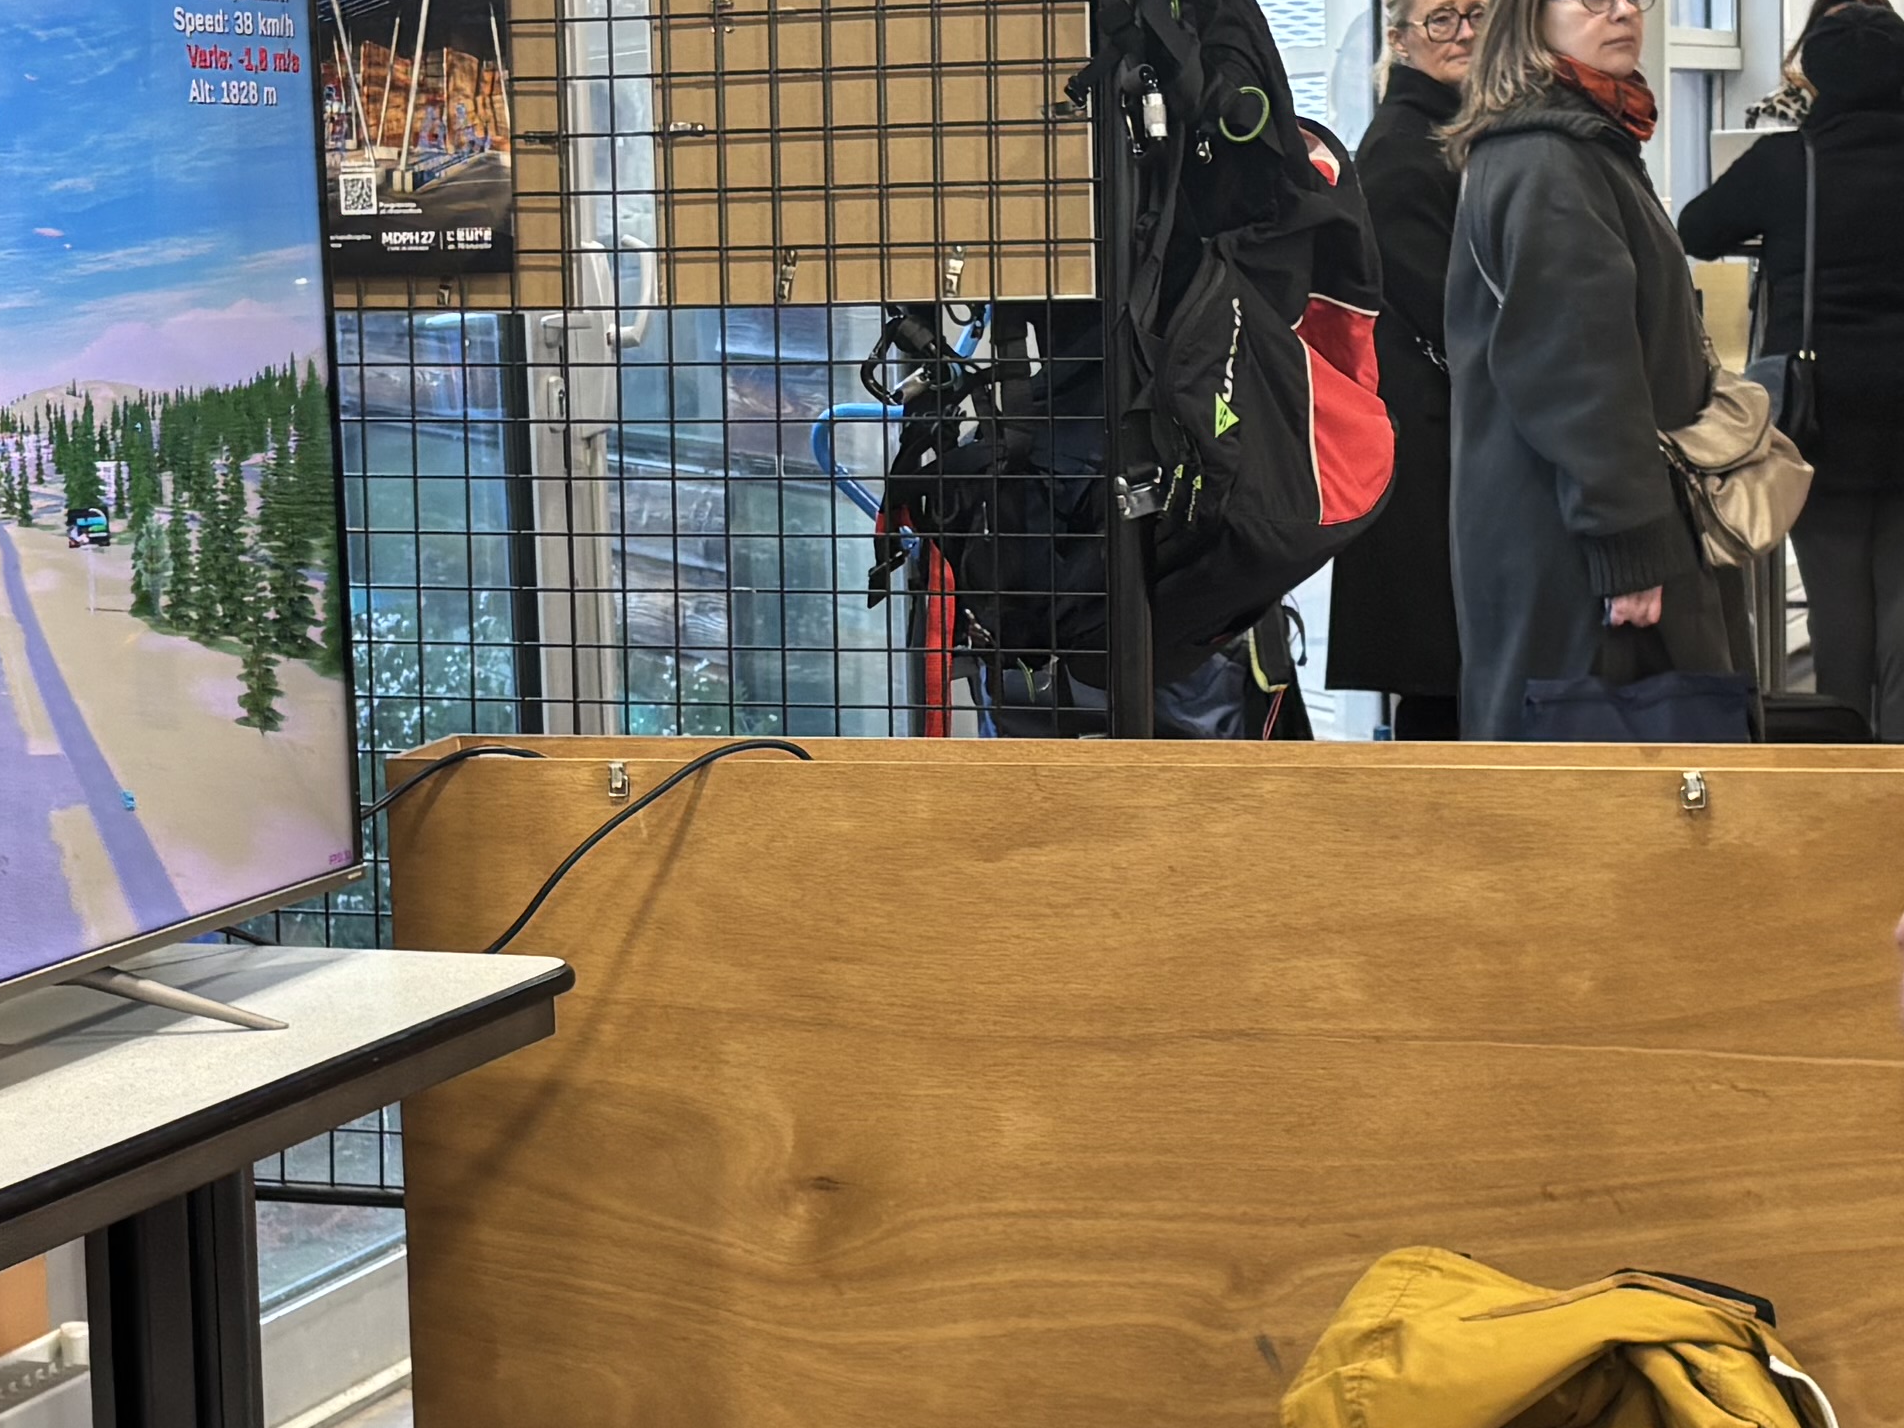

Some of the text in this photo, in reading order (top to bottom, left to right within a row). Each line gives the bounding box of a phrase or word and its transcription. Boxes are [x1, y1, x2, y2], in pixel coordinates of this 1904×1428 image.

[173, 6, 295, 38] Speed: 38 km/h
[188, 78, 216, 104] Alt:
[263, 86, 277, 106] m
